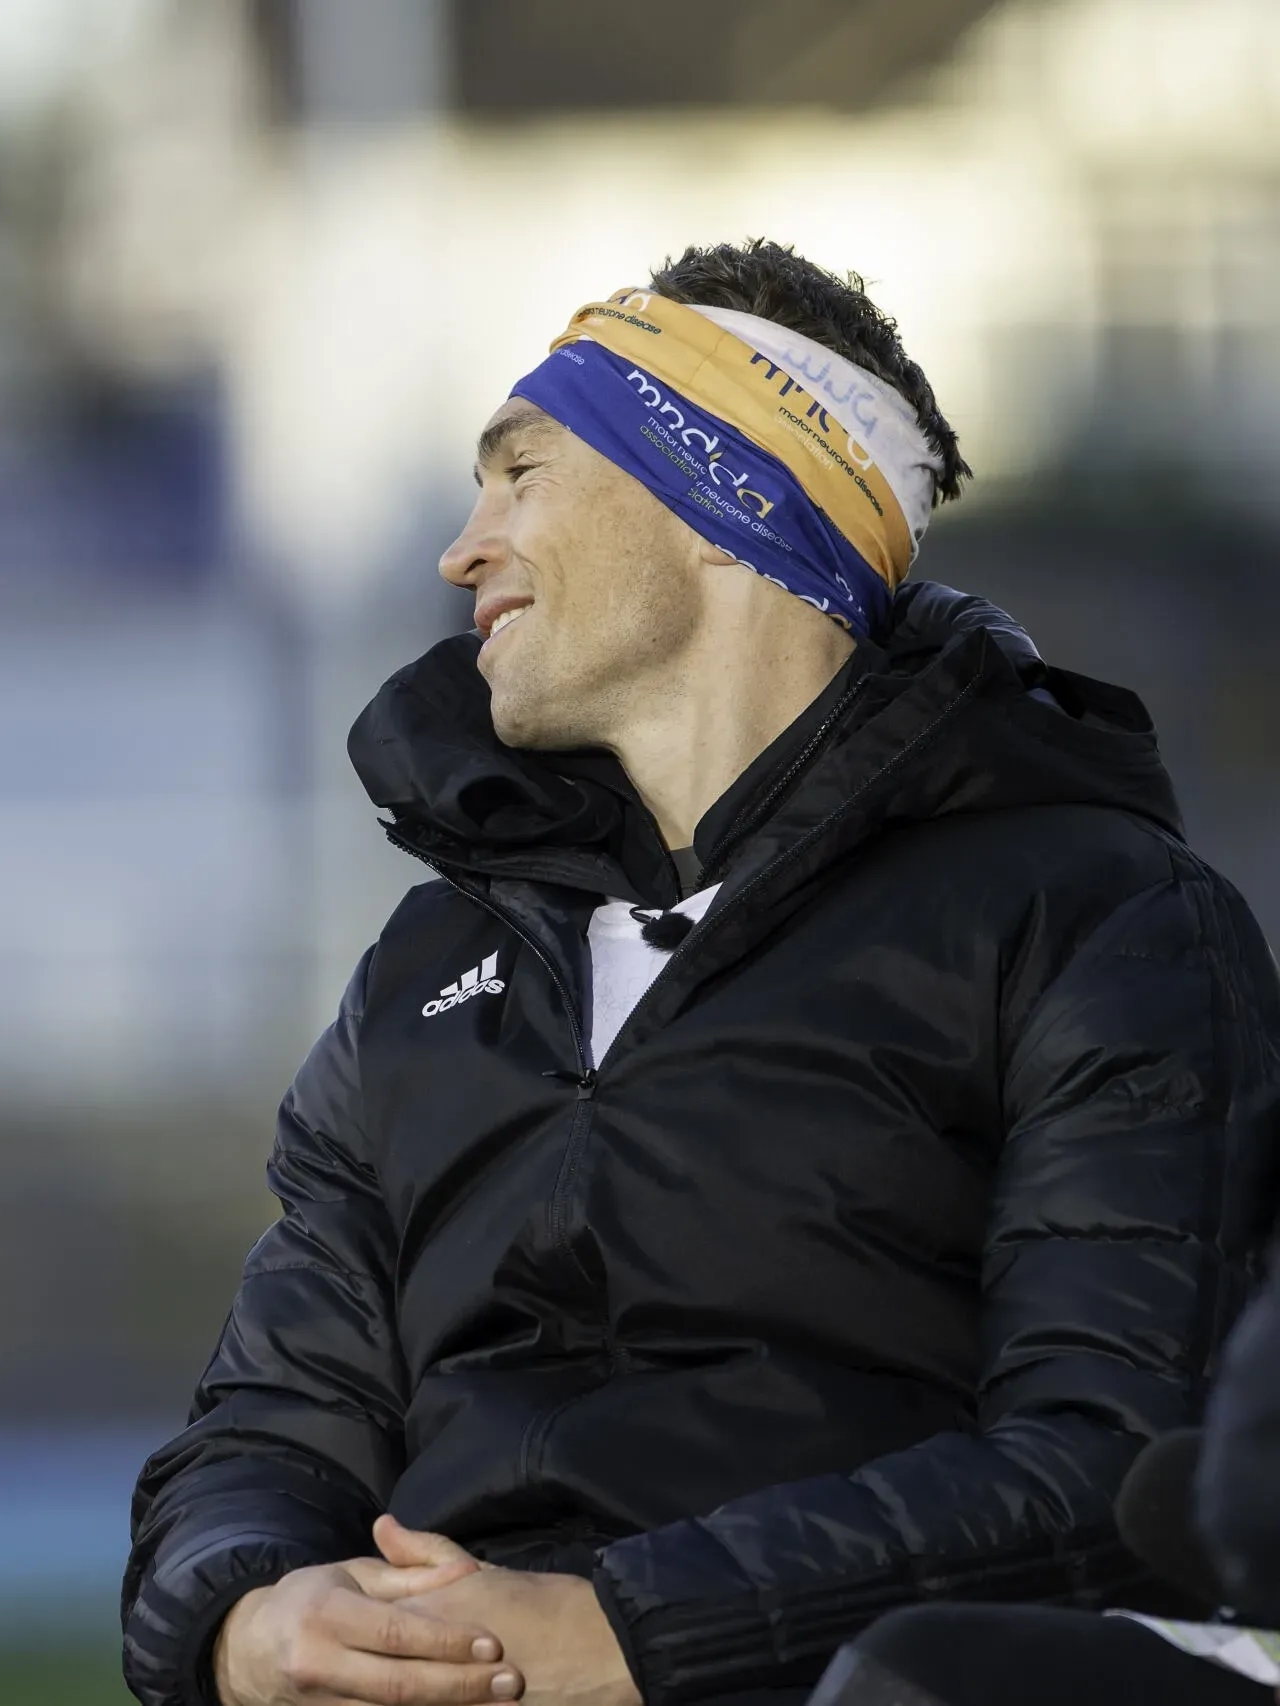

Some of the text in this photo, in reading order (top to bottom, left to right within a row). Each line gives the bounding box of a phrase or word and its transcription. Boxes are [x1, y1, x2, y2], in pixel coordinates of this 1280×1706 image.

[624, 315, 662, 334] disease
[639, 424, 698, 482] association
[647, 416, 678, 448] motor
[778, 406, 813, 434] motor
[812, 432, 855, 477] neurone
[854, 475, 884, 517] disease
[701, 485, 751, 525] neurone
[750, 521, 793, 553] disease
[421, 979, 506, 1017] adidas
